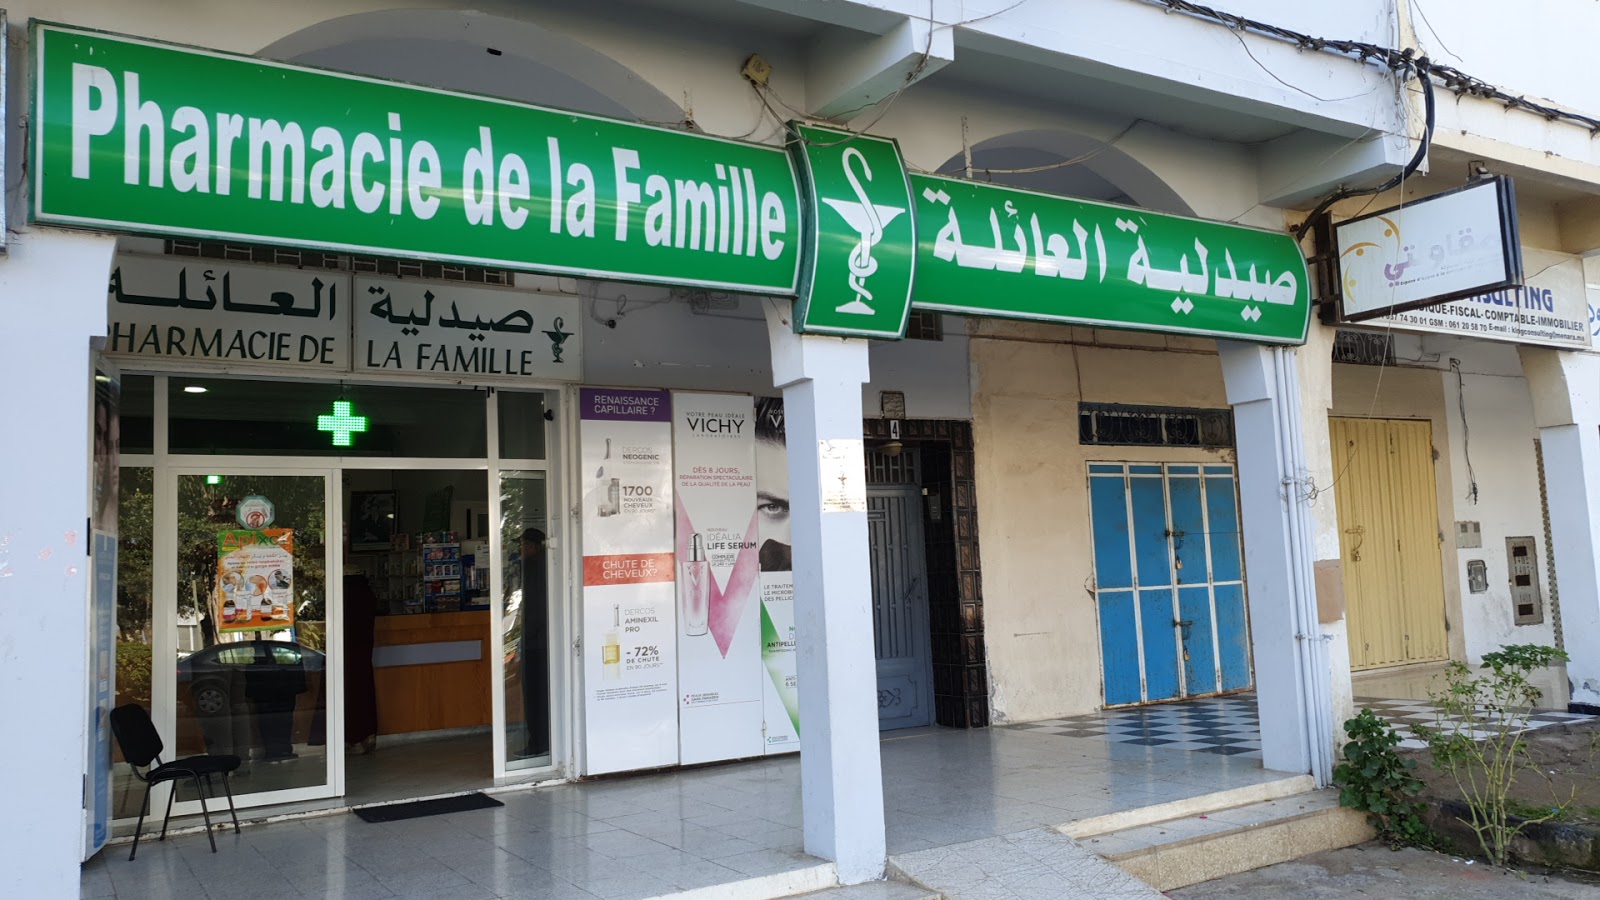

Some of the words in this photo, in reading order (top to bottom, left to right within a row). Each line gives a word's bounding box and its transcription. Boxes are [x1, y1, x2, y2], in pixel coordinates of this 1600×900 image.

[71, 61, 441, 221] Pharmacie
[463, 126, 531, 231] de
[547, 136, 595, 239] la
[612, 147, 787, 261] Famille
[922, 186, 1107, 285] العائلة
[1115, 216, 1298, 322] صيدلية
[368, 286, 534, 342] صيدلية
[1400, 314, 1408, 322] 74
[1410, 315, 1418, 323] 30
[1420, 317, 1427, 325] 01
[1429, 318, 1444, 327] GSM
[1449, 320, 1460, 329] 061
[1462, 322, 1469, 330] 20
[1471, 323, 1479, 331] 58
[1480, 324, 1487, 332] 70
[1489, 323, 1507, 332] E-mail
[106, 321, 292, 362] HARMACIE
[299, 335, 336, 365] DE
[367, 339, 402, 369] LA
[417, 343, 533, 376] FAMILLE
[594, 395, 660, 406] RENAISSANCE
[594, 405, 648, 415] CAPILLAIRE
[650, 407, 656, 415] ?
[687, 418, 745, 434] VICHY
[892, 421, 898, 438] 4
[622, 446, 653, 454] DERCOS
[715, 467, 740, 475] JOURS,
[622, 486, 653, 496] 1700
[706, 532, 742, 541] IDÉALIA
[707, 542, 726, 550] LIFE
[728, 541, 757, 550] SERUM
[602, 560, 638, 570] CHUTE
[640, 559, 656, 568] DE
[602, 568, 657, 580] CHEVEUX?
[624, 607, 655, 615] DERCOS
[634, 645, 659, 657] 72%
